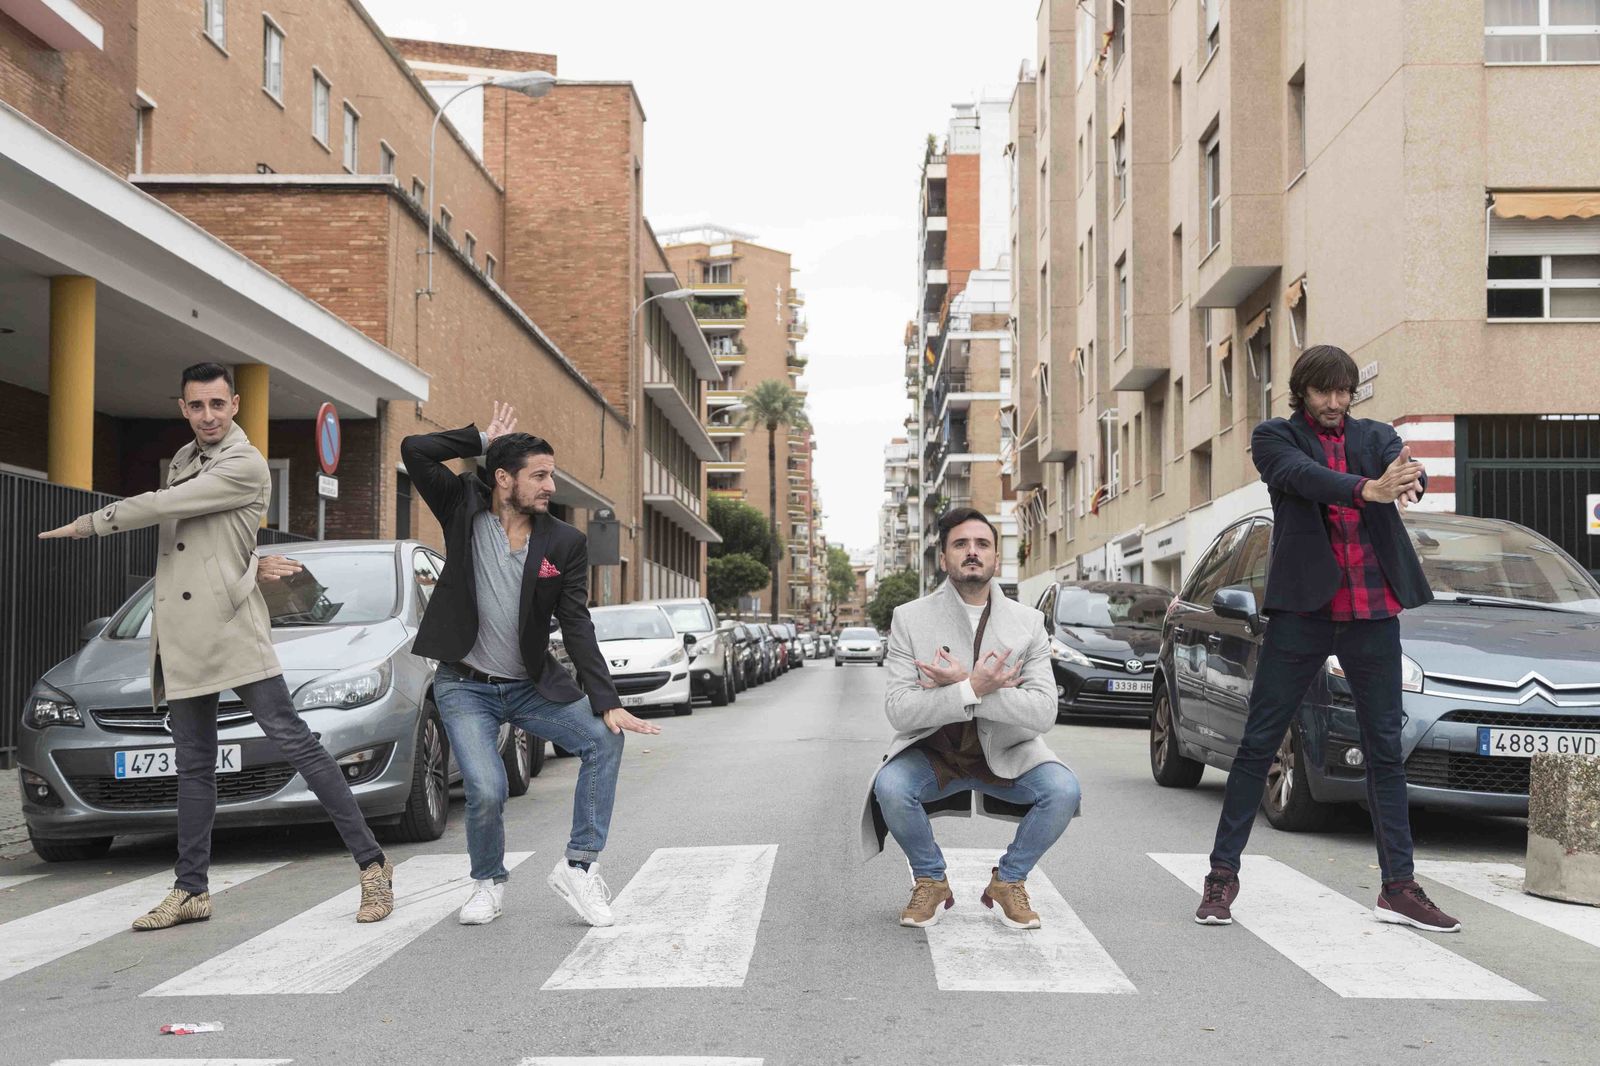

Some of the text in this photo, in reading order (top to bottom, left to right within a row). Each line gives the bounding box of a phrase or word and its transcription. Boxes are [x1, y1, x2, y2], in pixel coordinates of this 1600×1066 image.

[1140, 682, 1152, 692] HR
[1495, 732, 1596, 755] 4883 GVD
[131, 752, 170, 774] 473
